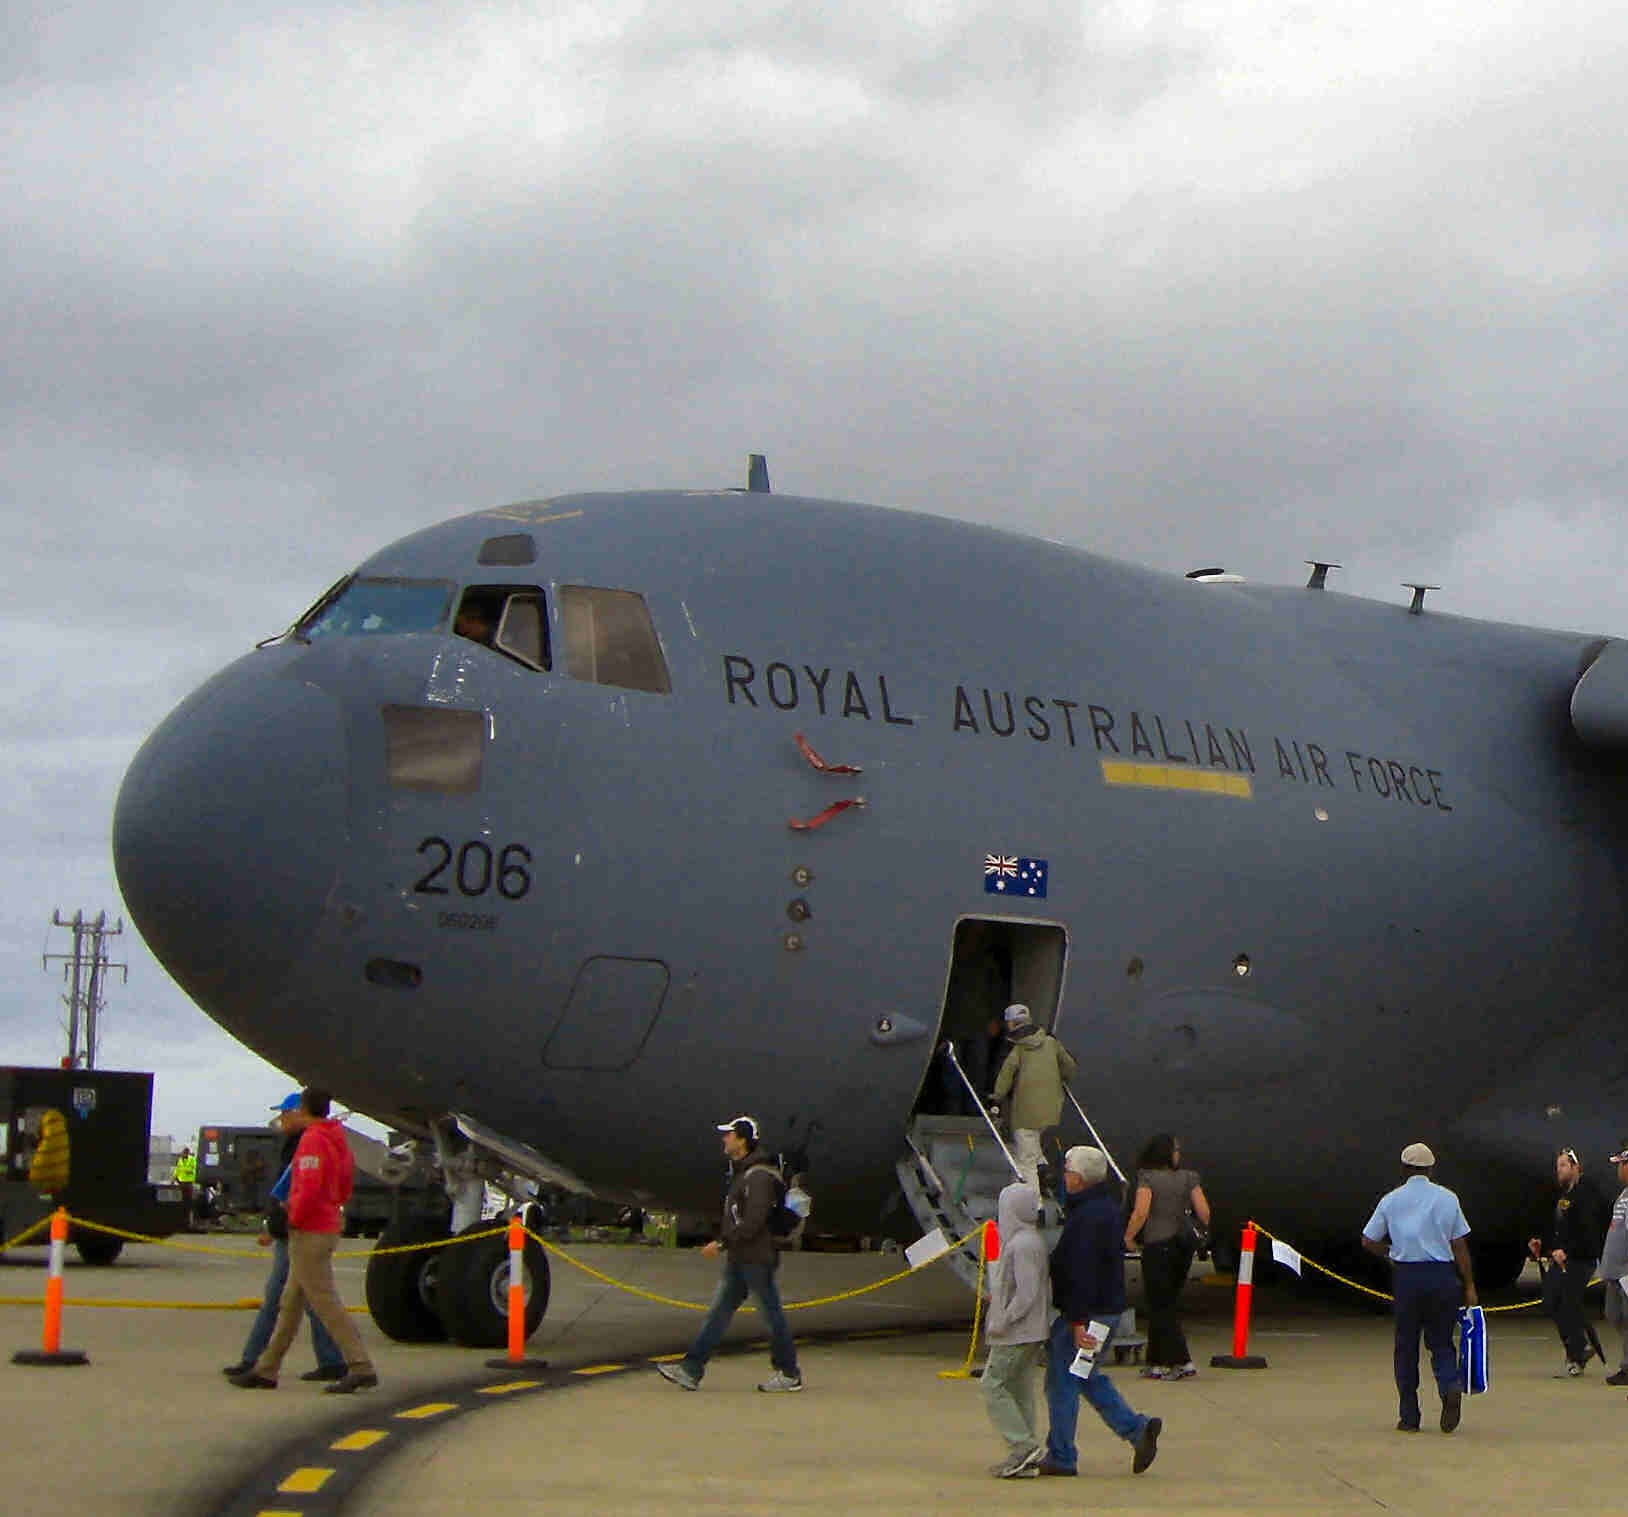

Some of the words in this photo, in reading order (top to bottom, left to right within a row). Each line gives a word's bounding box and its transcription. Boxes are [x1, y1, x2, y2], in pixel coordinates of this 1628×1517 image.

[724, 655, 913, 725] ROYAL
[953, 685, 1255, 774] AUSTRALIAN
[1273, 736, 1335, 788] AIR
[1345, 750, 1453, 812] FORCE
[414, 836, 532, 899] 206
